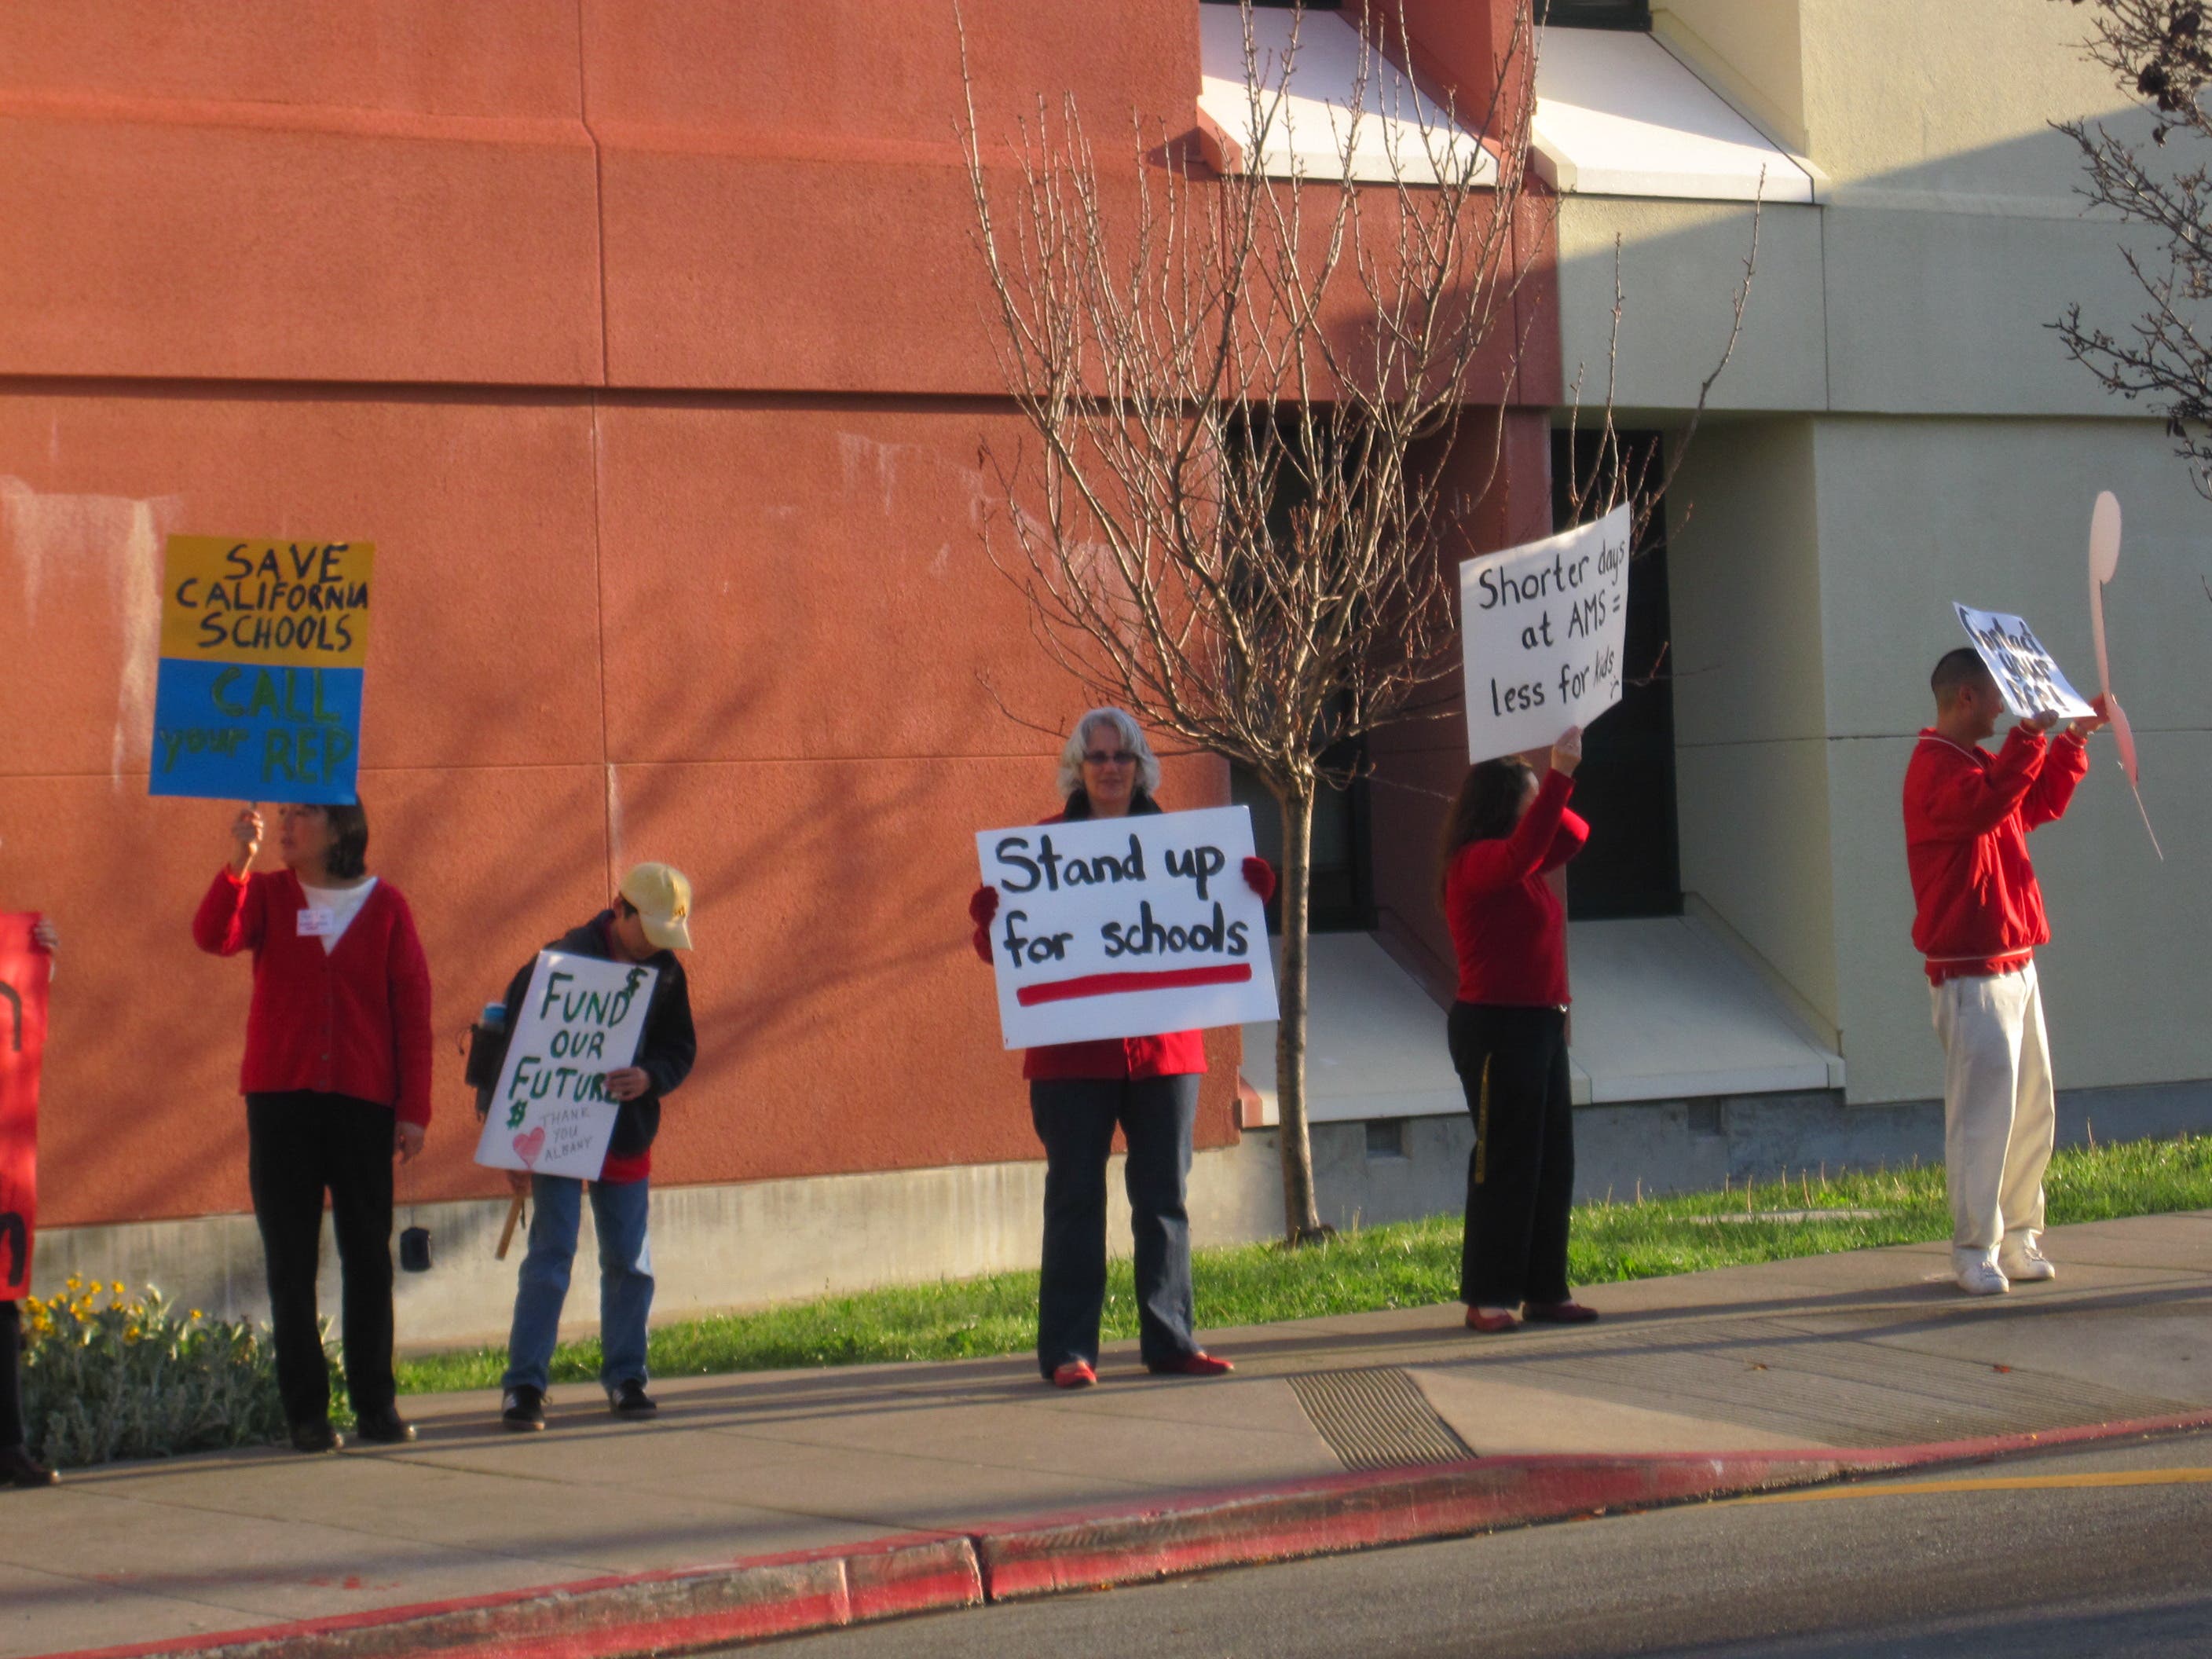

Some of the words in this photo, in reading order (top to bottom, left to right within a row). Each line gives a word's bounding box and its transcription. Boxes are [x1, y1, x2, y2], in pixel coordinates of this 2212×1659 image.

[225, 544, 350, 584] SAVE
[1478, 553, 1590, 610] Shorter
[1598, 539, 1625, 586] days
[176, 577, 368, 613] CALIFORNIA
[1522, 610, 1554, 650] at
[1568, 589, 1606, 639] AMS
[198, 612, 353, 652] SCHOOLS
[1959, 606, 2043, 656] Contact
[211, 667, 342, 723] CALL
[1491, 678, 1546, 717] less
[1558, 663, 1590, 705] for
[1593, 645, 1615, 688] kids
[159, 727, 250, 775] your
[261, 726, 353, 785] REP
[995, 833, 1147, 894] Stand
[1164, 845, 1226, 901] up
[1003, 910, 1075, 969] for
[1101, 900, 1250, 958] schools
[550, 1030, 606, 1060] OUR
[540, 1107, 591, 1128] THANK
[553, 1126, 578, 1144] YOU
[545, 1135, 595, 1163] ALBANY
